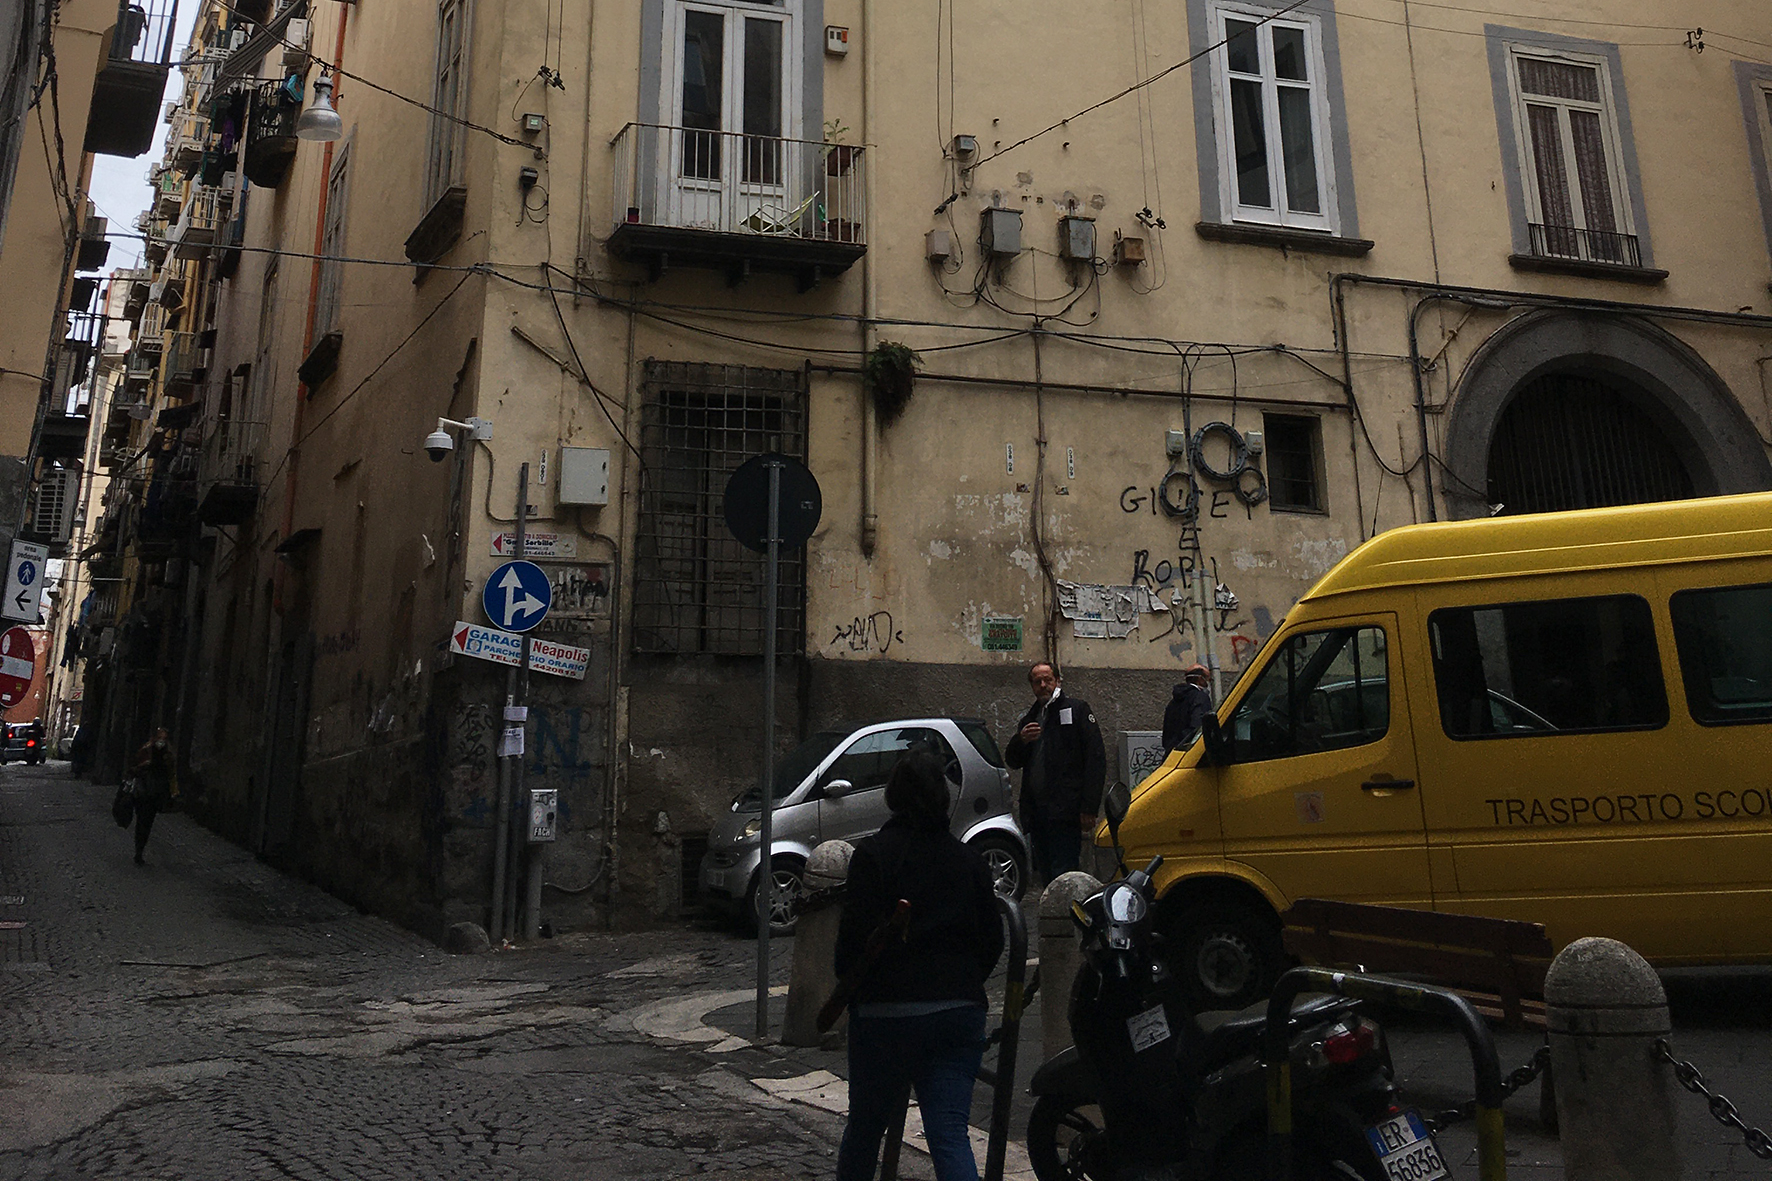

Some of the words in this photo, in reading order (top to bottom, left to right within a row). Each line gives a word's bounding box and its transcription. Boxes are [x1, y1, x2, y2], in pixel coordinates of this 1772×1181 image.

[16, 552, 42, 562] pedonale
[469, 629, 522, 648] GARAG
[532, 640, 590, 663] Neapolis
[484, 644, 546, 664] PARCHEGIO
[548, 659, 585, 672] ORARIO
[1485, 793, 1684, 825] TRASPORTO
[1379, 1121, 1408, 1151] ER
[1387, 1145, 1441, 1181] 56836
